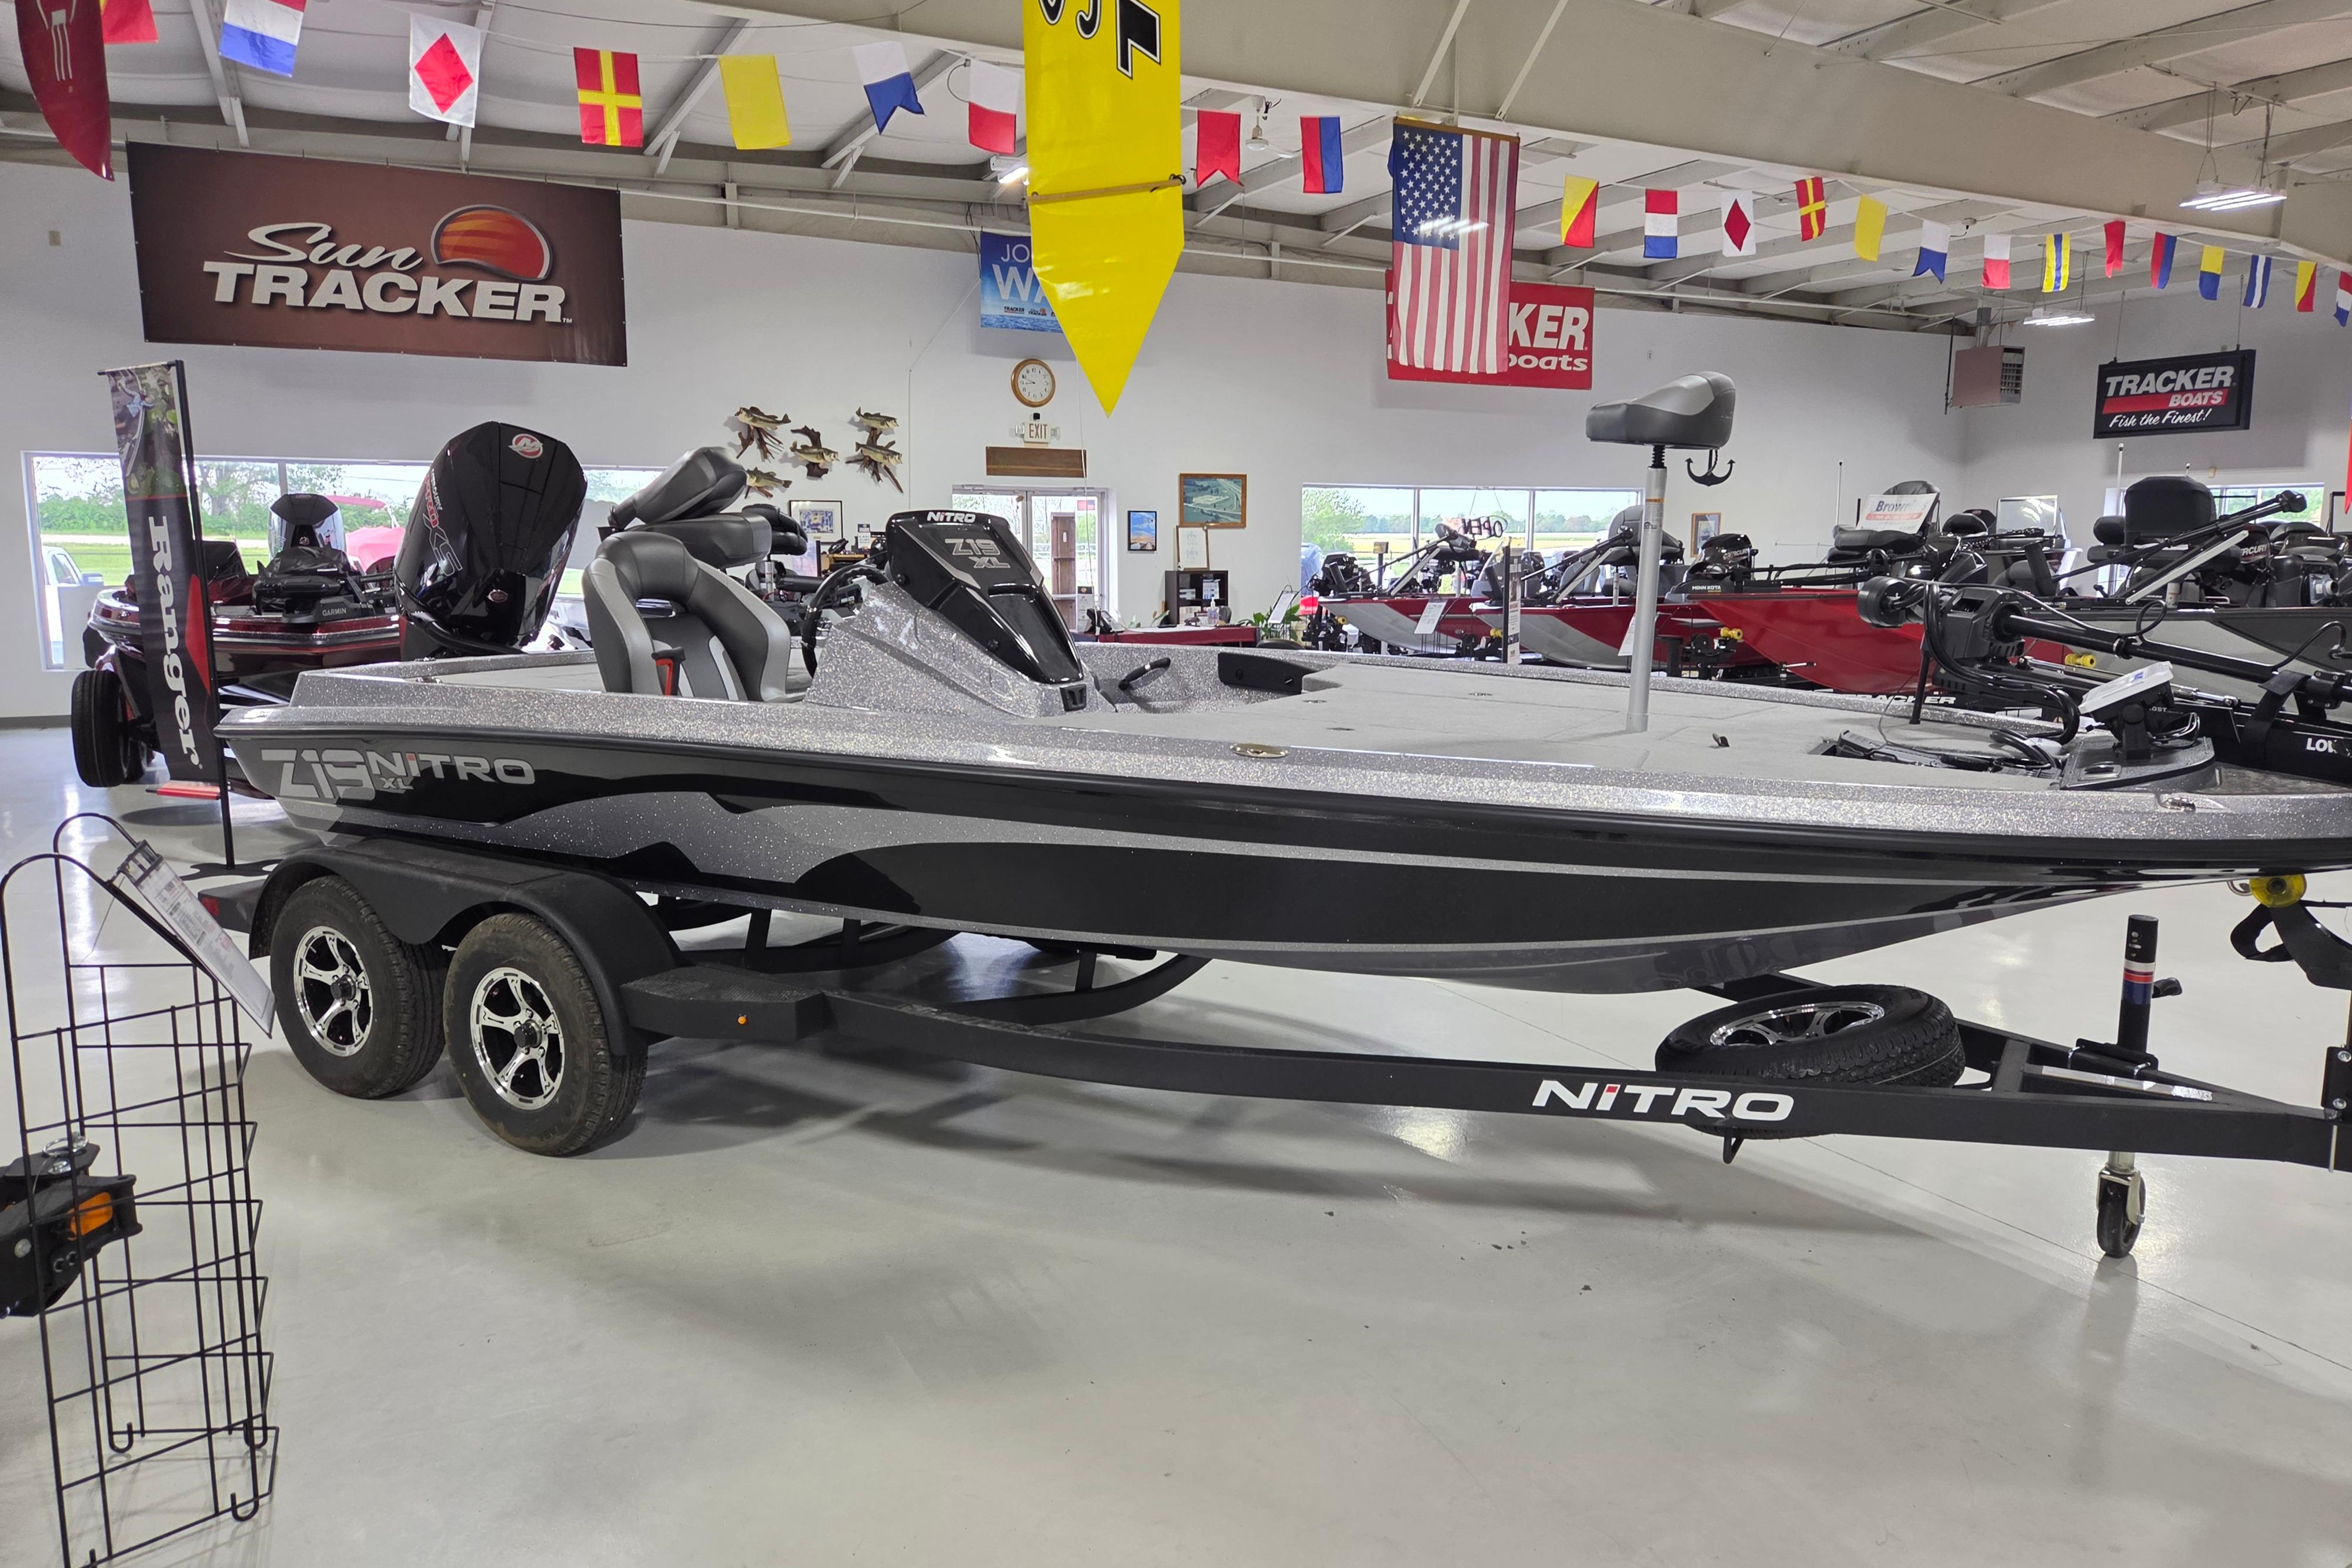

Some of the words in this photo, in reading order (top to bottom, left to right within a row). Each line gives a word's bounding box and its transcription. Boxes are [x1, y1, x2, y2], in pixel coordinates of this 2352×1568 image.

[223, 222, 424, 271] Sun
[203, 260, 566, 323] TRACKER
[2106, 366, 2234, 397] TRACKER
[2169, 390, 2223, 407] BOATS
[2109, 414, 2137, 428] Fish
[2140, 413, 2160, 426] the
[2161, 408, 2213, 424] Finest!
[1029, 423, 1048, 439] EXIT
[423, 513, 463, 576] XS
[945, 539, 1000, 555] Z19
[968, 556, 1011, 568] XL
[322, 607, 346, 617] GARMIN
[148, 516, 200, 767] Ranger
[261, 748, 375, 801] Z19
[379, 777, 414, 791] XL
